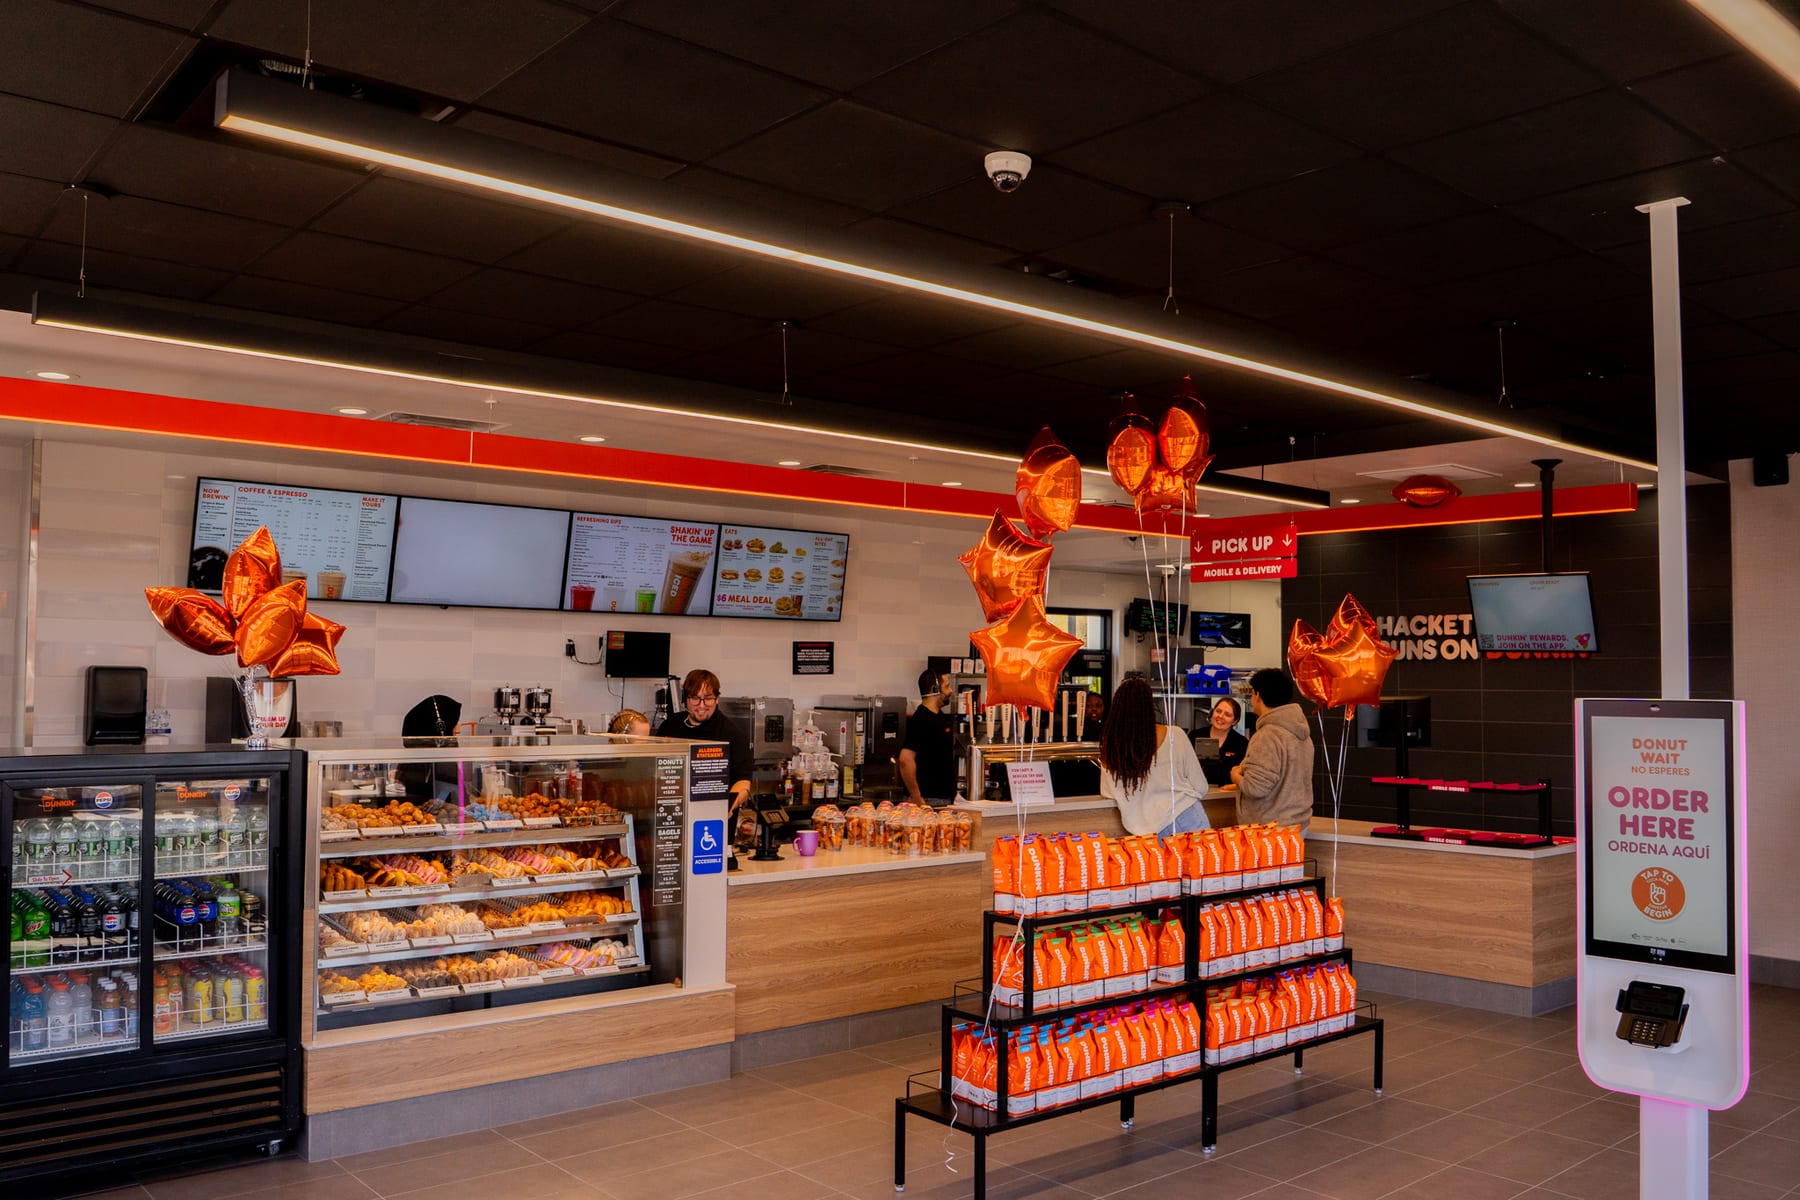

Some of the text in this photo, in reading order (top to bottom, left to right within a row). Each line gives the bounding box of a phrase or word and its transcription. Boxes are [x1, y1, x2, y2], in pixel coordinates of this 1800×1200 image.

[238, 487, 266, 495] COFFEE
[273, 489, 308, 498] ESPRESSO
[670, 526, 715, 536] SHAKIN' UP
[671, 534, 712, 544] THE GAME
[1212, 535, 1274, 554] PICK UP
[1204, 565, 1282, 578] MOBILE & DELIVERY
[670, 574, 682, 598] ICED
[716, 594, 774, 604] $6 MEAL DEAL
[1530, 634, 1569, 642] REWARDS.
[1381, 639, 1437, 660] UNS
[1440, 638, 1478, 660] ON
[1632, 738, 1688, 751] DONUT
[1640, 752, 1680, 764] WAIT
[1632, 766, 1690, 776] NO ESPERES
[1608, 786, 1709, 814] ORDER
[1620, 814, 1695, 840] HERE
[1608, 840, 1710, 860] ORDENA AQUÍ
[1640, 869, 1674, 882] TAP TO
[1644, 906, 1673, 918] BEGIN
